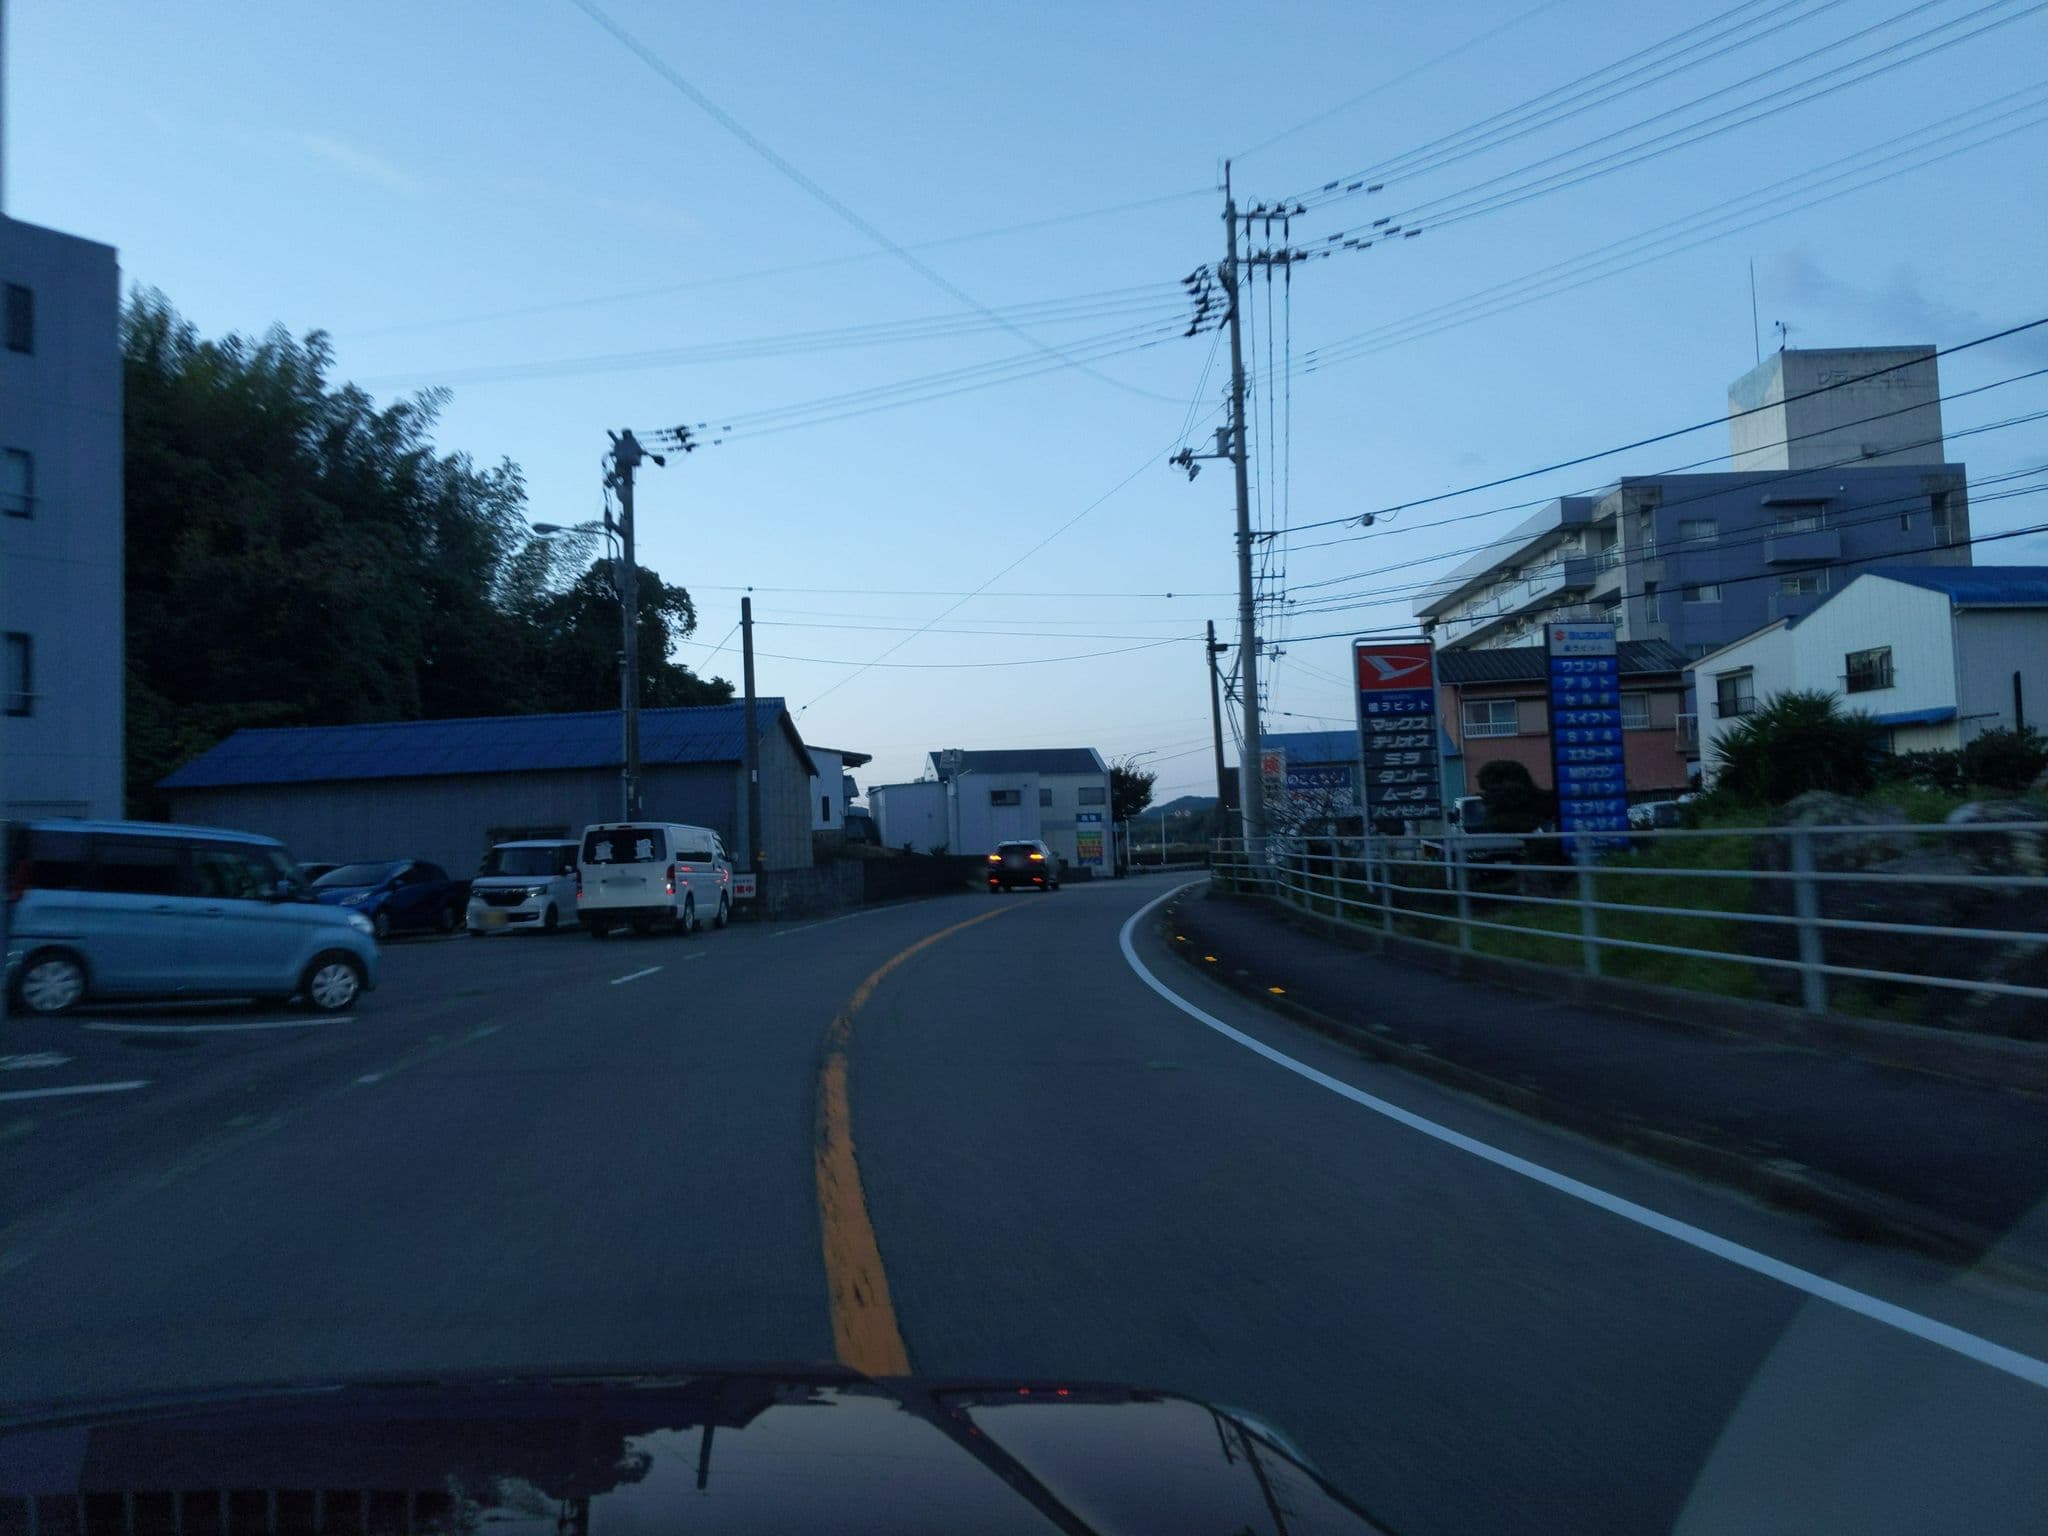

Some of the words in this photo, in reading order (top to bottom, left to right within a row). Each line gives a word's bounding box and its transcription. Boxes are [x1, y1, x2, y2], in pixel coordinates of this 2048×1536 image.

[1370, 717, 1428, 731] マックス
[1372, 734, 1429, 749] テリオス
[1384, 752, 1420, 766] ミラ
[1378, 769, 1428, 783] タント
